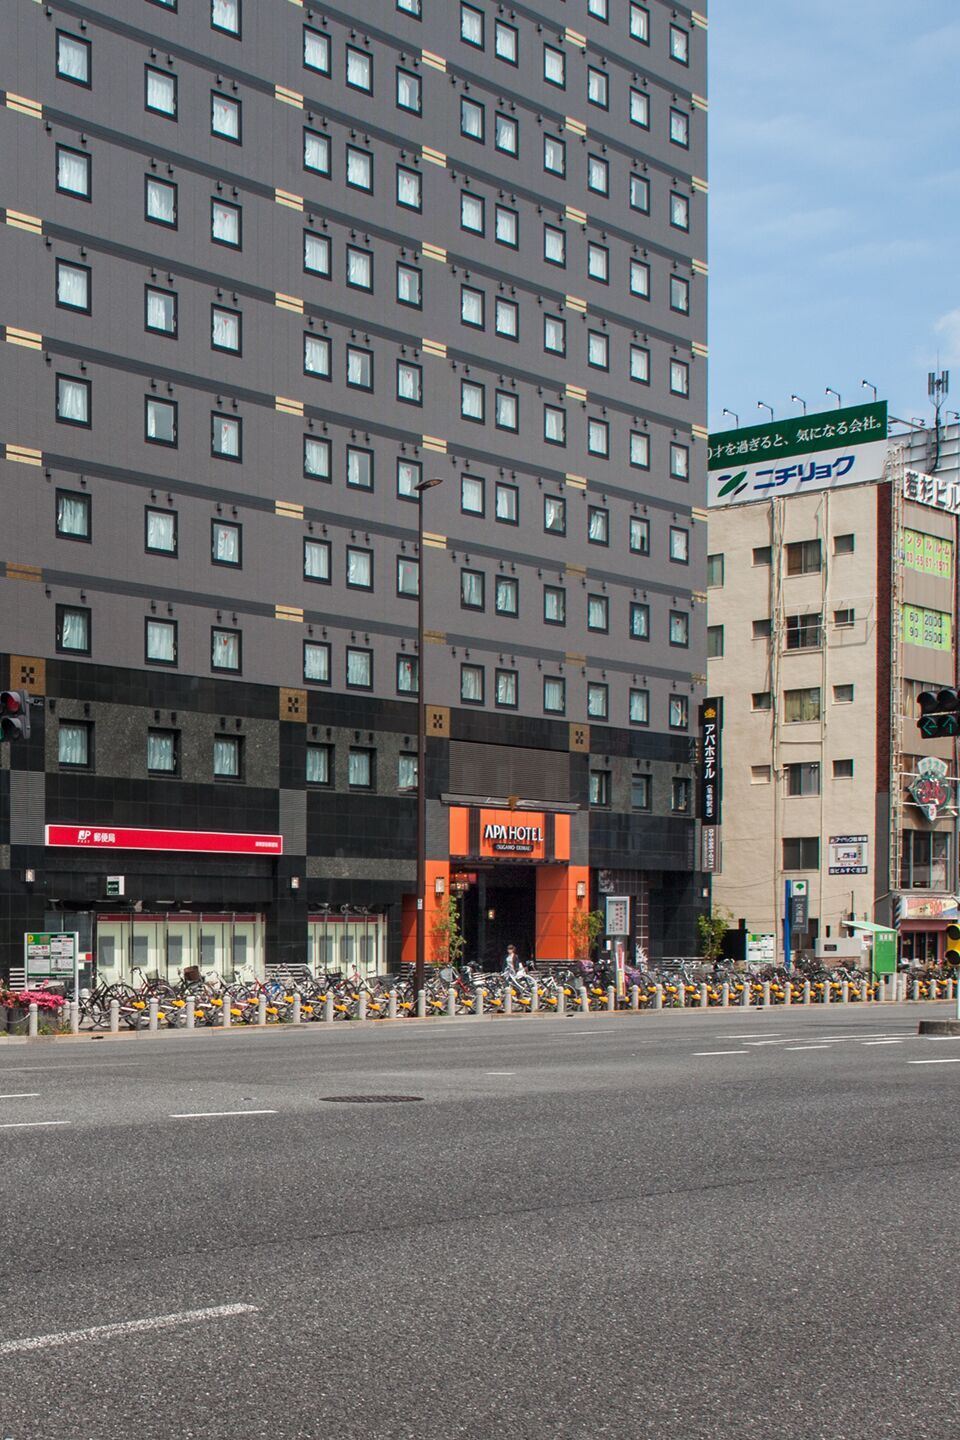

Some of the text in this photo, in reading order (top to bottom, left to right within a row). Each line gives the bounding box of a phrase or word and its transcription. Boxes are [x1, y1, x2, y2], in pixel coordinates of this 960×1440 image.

[753, 455, 855, 490] ニチリョク
[704, 723, 716, 779] アパホテル
[485, 824, 544, 841] APA HOTEL
